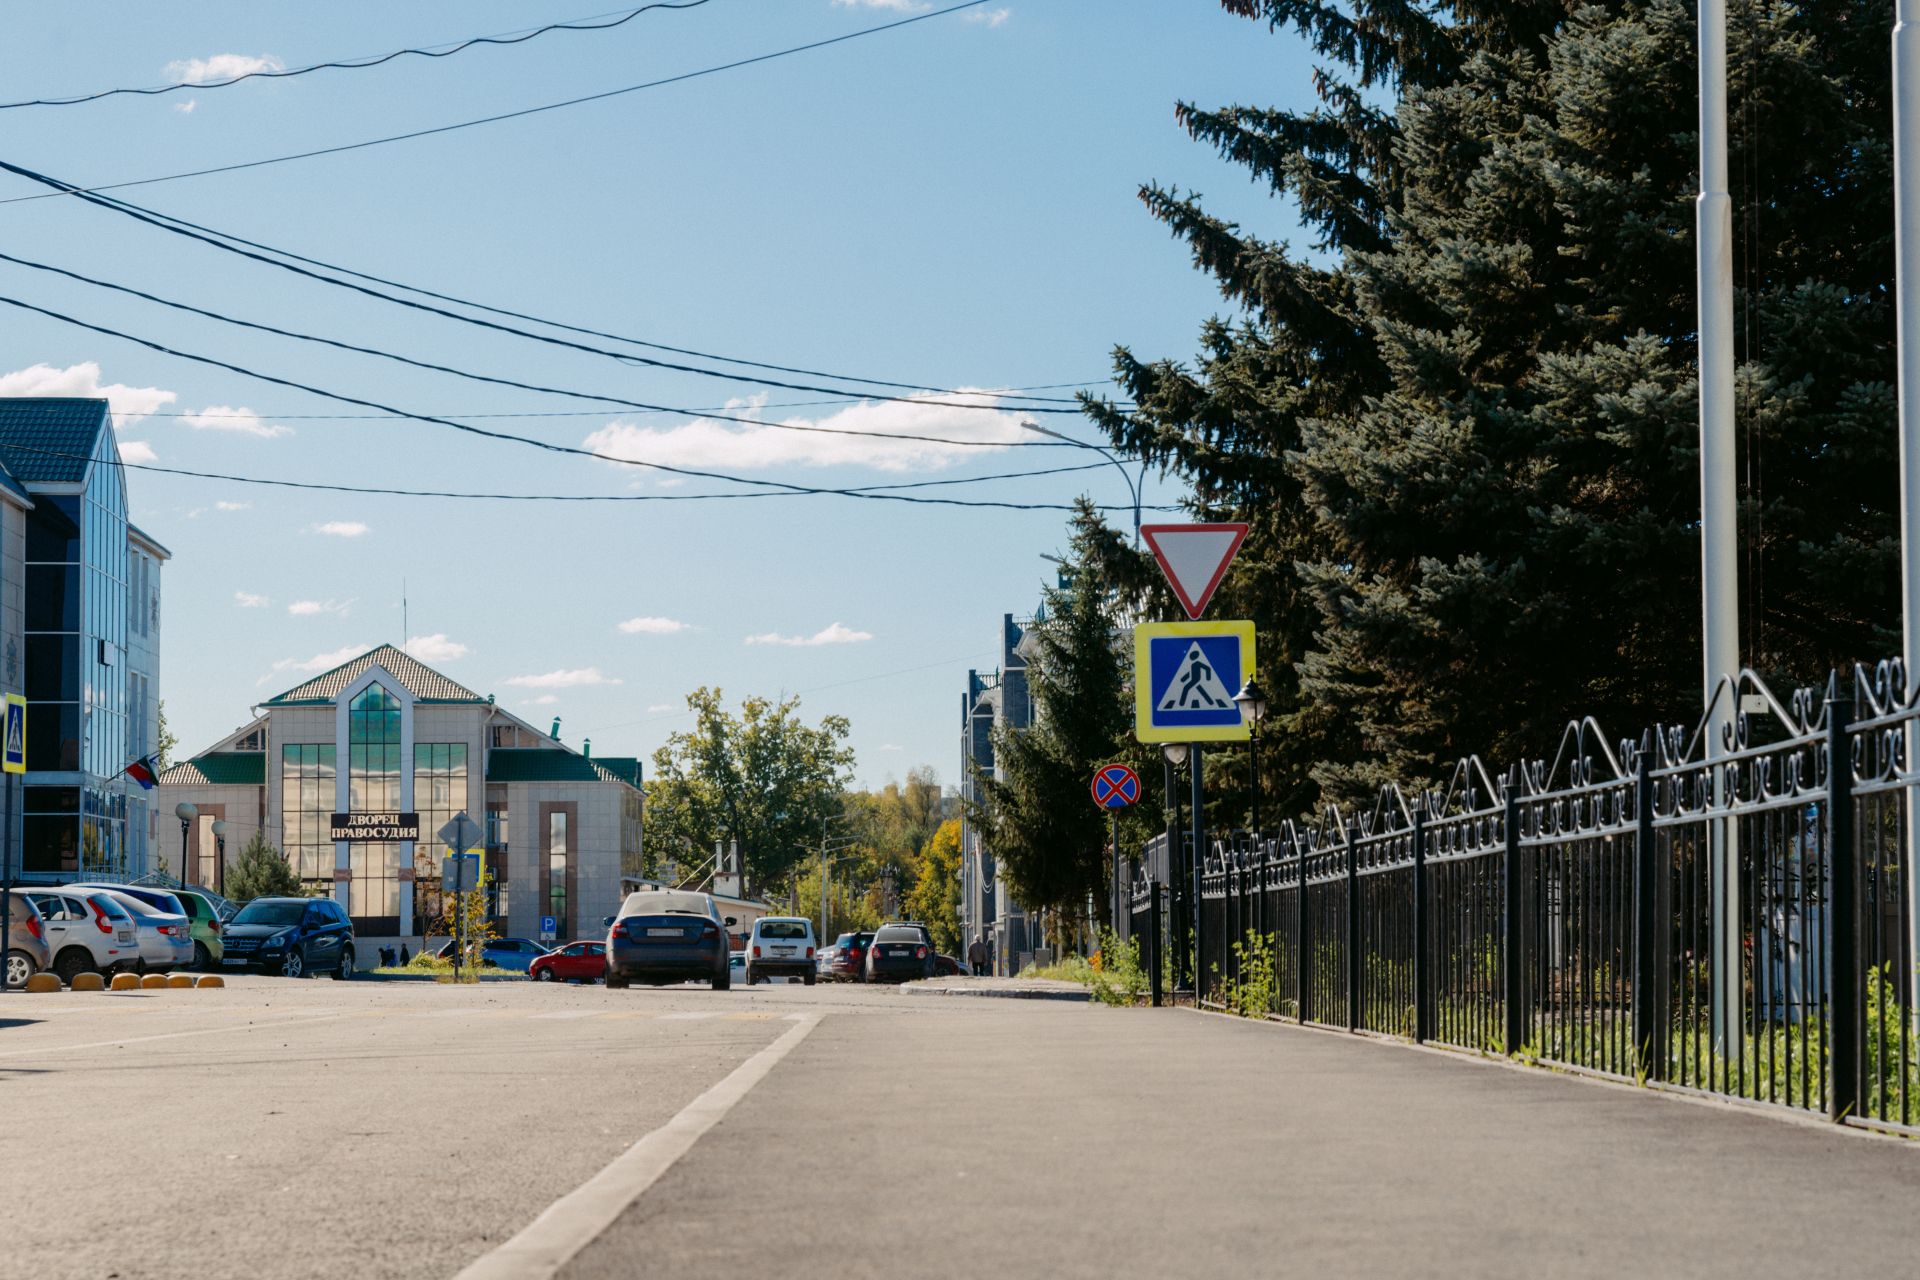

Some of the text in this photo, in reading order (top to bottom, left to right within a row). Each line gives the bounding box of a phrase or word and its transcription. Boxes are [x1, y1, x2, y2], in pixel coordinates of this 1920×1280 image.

[348, 815, 399, 826] ДВОРЕЦ
[331, 827, 417, 839] ПРАВОСУДИЯ
[544, 918, 554, 931] P
